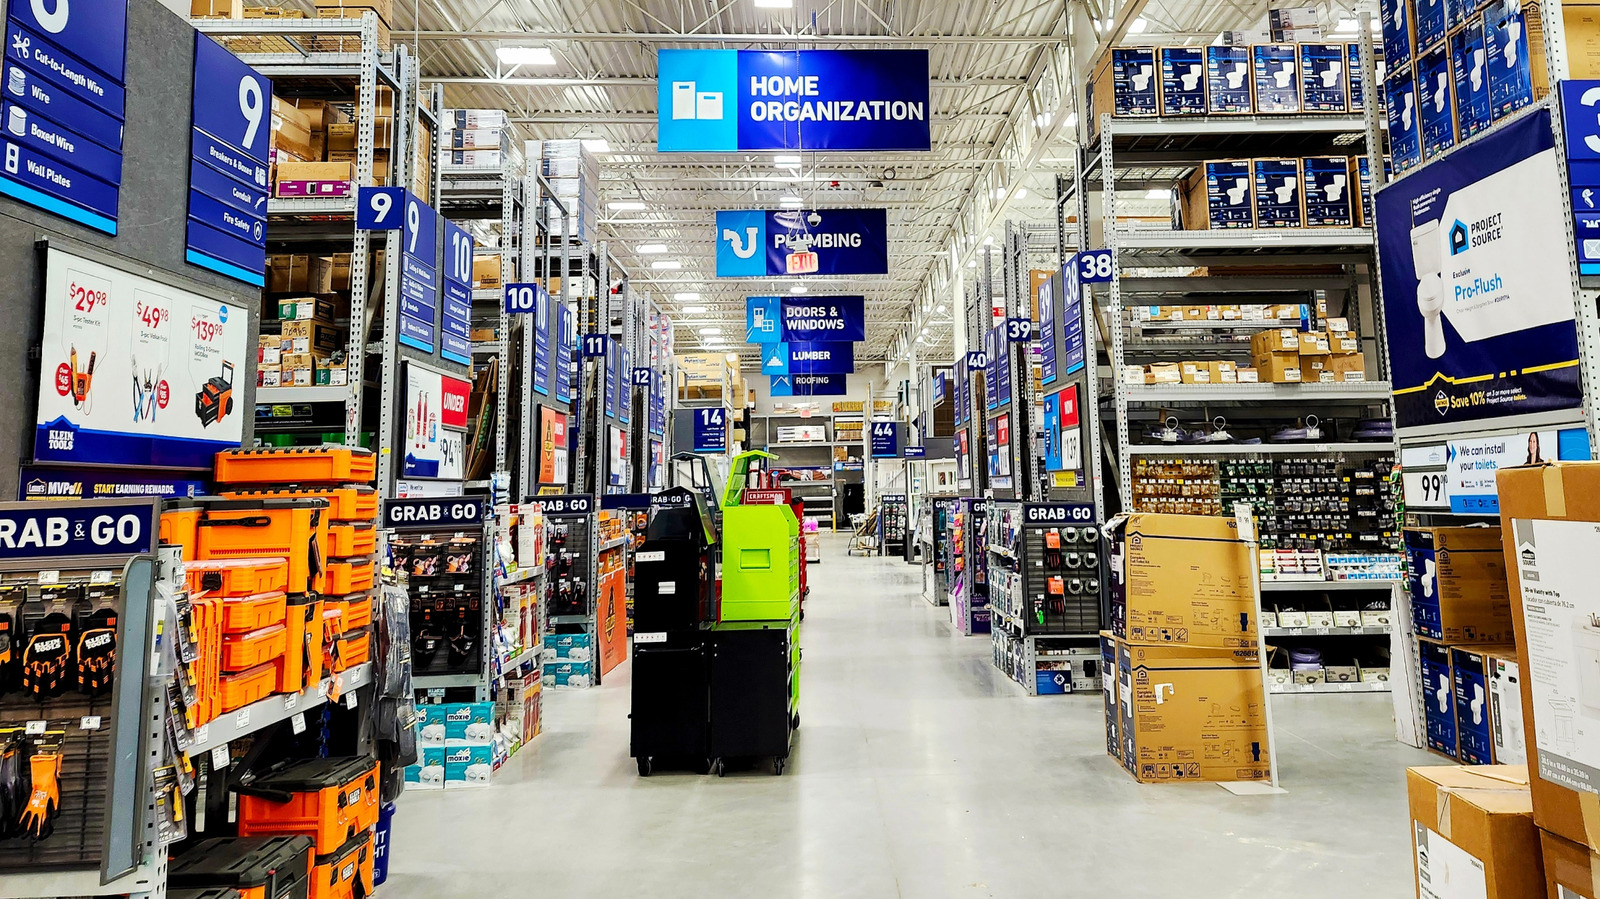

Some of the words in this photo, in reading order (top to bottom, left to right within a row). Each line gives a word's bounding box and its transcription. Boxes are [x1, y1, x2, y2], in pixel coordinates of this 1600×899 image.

[34, 48, 86, 88] Cut-to-Length
[86, 78, 104, 97] Wire
[31, 84, 50, 104] Wire
[750, 76, 819, 96] HOME
[239, 75, 263, 149] 9
[750, 102, 924, 122] ORGANIZATION
[31, 124, 54, 146] Boxed
[56, 133, 74, 153] Wire
[27, 159, 46, 179] Wall
[46, 168, 71, 188] Plates
[370, 192, 392, 222] 9
[407, 201, 420, 253] 9
[1471, 212, 1502, 234] PROJECT
[1472, 228, 1502, 248] SOURCE
[452, 232, 470, 282] 10
[792, 254, 814, 270] EXIT
[1081, 254, 1112, 278] 38
[1066, 260, 1078, 304] 38
[1452, 268, 1470, 279] Exclusive
[1454, 272, 1502, 302] Pro-Flush
[508, 287, 533, 309] 10
[1040, 284, 1050, 323] 39
[536, 290, 546, 330] 10
[786, 307, 826, 318] DOORS
[830, 306, 838, 317] &
[786, 319, 845, 331] WINDOWS
[1008, 320, 1030, 338] 39
[586, 336, 603, 354] 11
[792, 351, 831, 361] LUMBER
[968, 353, 987, 368] 40
[634, 370, 649, 384] 12
[796, 377, 830, 385] ROOFING
[444, 392, 464, 413] UNDER
[1451, 396, 1470, 409] Save
[1470, 390, 1485, 406] 10%
[702, 409, 722, 425] 14
[49, 430, 74, 441] KLEIN
[874, 423, 892, 436] 44
[49, 440, 74, 450] TOOLS
[1460, 446, 1470, 457] We
[1471, 447, 1483, 456] can
[1484, 442, 1505, 454] install
[1460, 462, 1474, 473] your
[1475, 460, 1498, 470] toilets.
[94, 484, 115, 494] START
[115, 484, 144, 494] EARNING
[145, 485, 175, 494] REWARDS.
[390, 504, 442, 521] GRAB
[444, 507, 449, 517] &
[452, 504, 476, 519] GO
[570, 500, 588, 511] GO
[1029, 507, 1065, 520] GRAB
[1073, 507, 1090, 519] GO
[74, 520, 85, 538] &
[91, 514, 141, 546] GO
